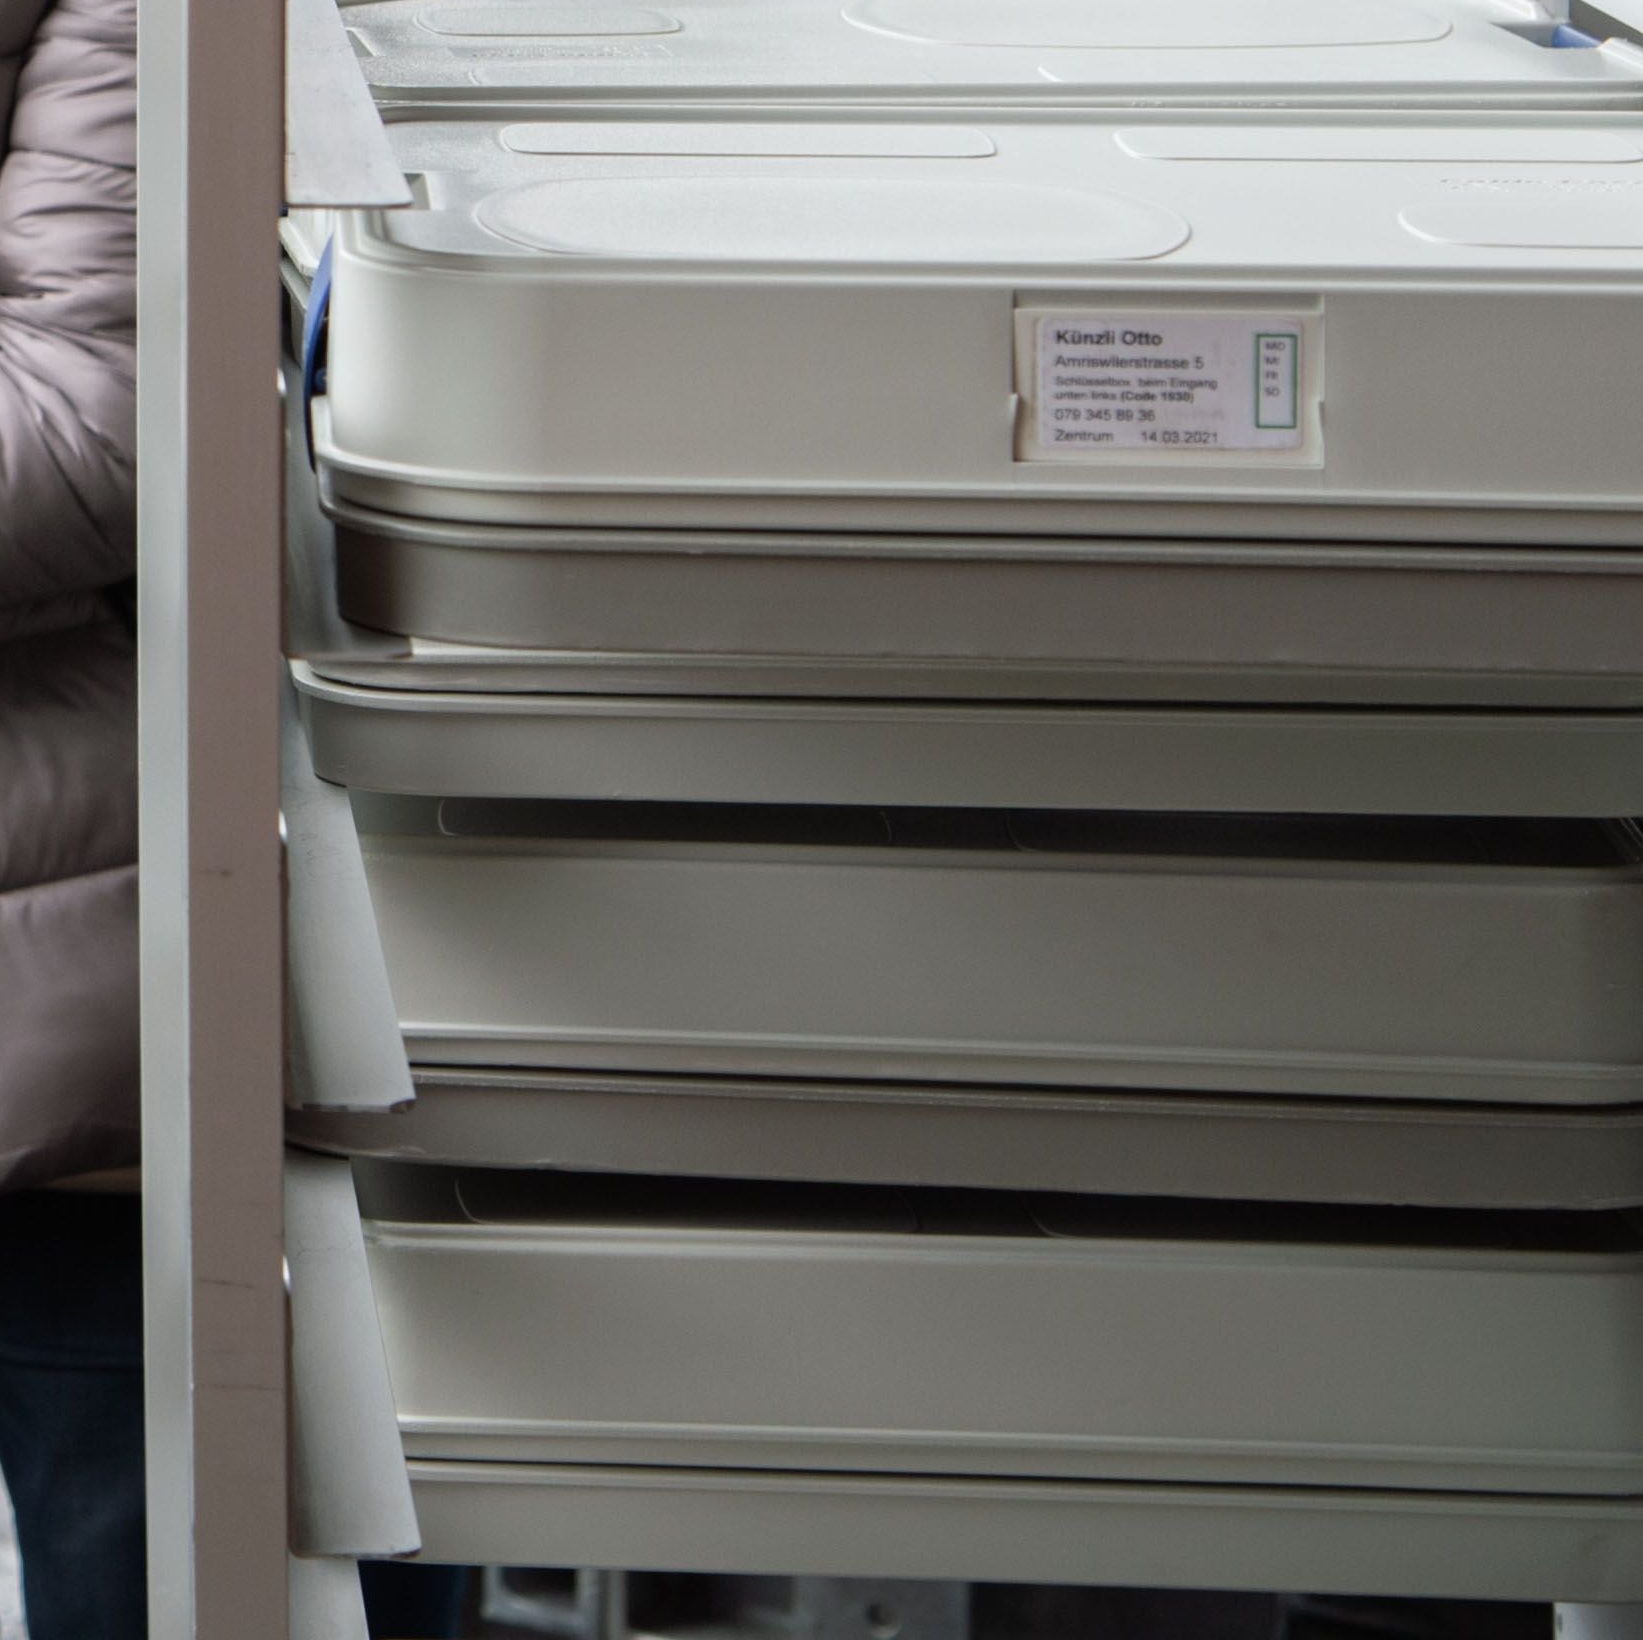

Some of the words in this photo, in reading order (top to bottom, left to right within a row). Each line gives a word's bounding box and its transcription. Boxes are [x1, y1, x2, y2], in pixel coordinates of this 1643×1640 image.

[1056, 329, 1116, 346] Künzli
[1122, 330, 1164, 346] Otto
[1055, 354, 1190, 370] Amriswilerstrasse
[1194, 356, 1205, 370] 5
[1138, 377, 1167, 388] beim
[1170, 377, 1218, 391] Eingang
[1121, 391, 1157, 403] (Code
[1054, 408, 1081, 422] 079
[1085, 408, 1112, 422] 345
[1054, 428, 1114, 443] Zentrum
